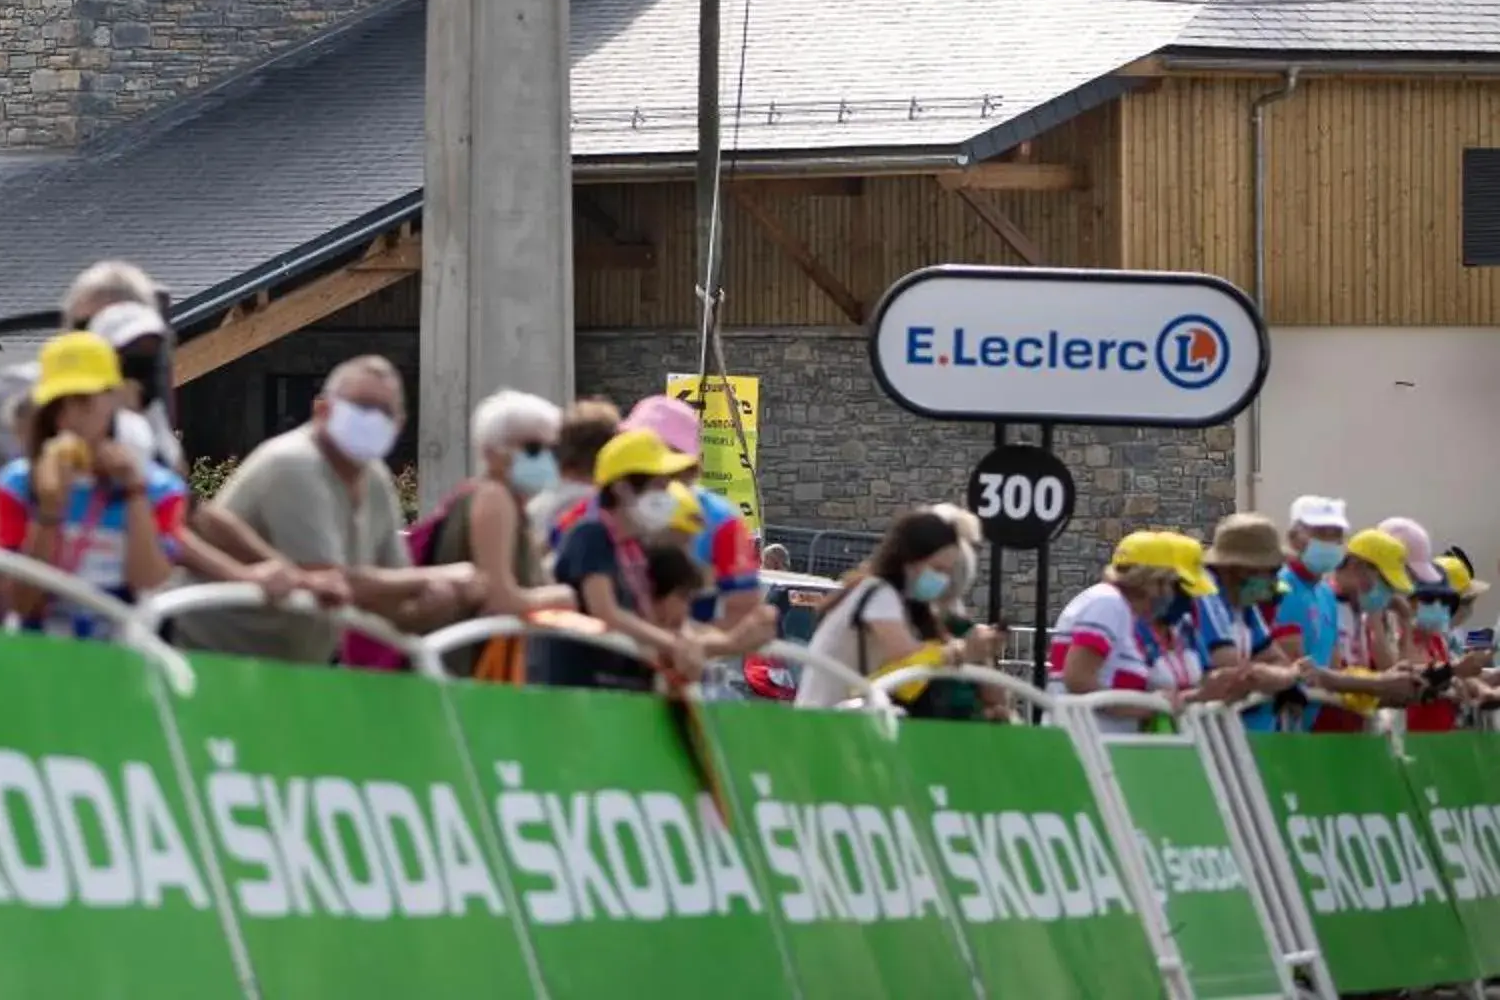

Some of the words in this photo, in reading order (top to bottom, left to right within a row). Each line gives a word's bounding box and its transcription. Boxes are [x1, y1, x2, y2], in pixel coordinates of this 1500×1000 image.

[906, 326, 1148, 370] E.Leclerc
[977, 473, 1064, 522] 300
[207, 737, 506, 918] ŠKODA
[494, 760, 763, 924] ŠKODA
[751, 773, 951, 923] ŠKODA
[928, 786, 1135, 923] ŠKODA
[1284, 793, 1448, 914] ŠKODA
